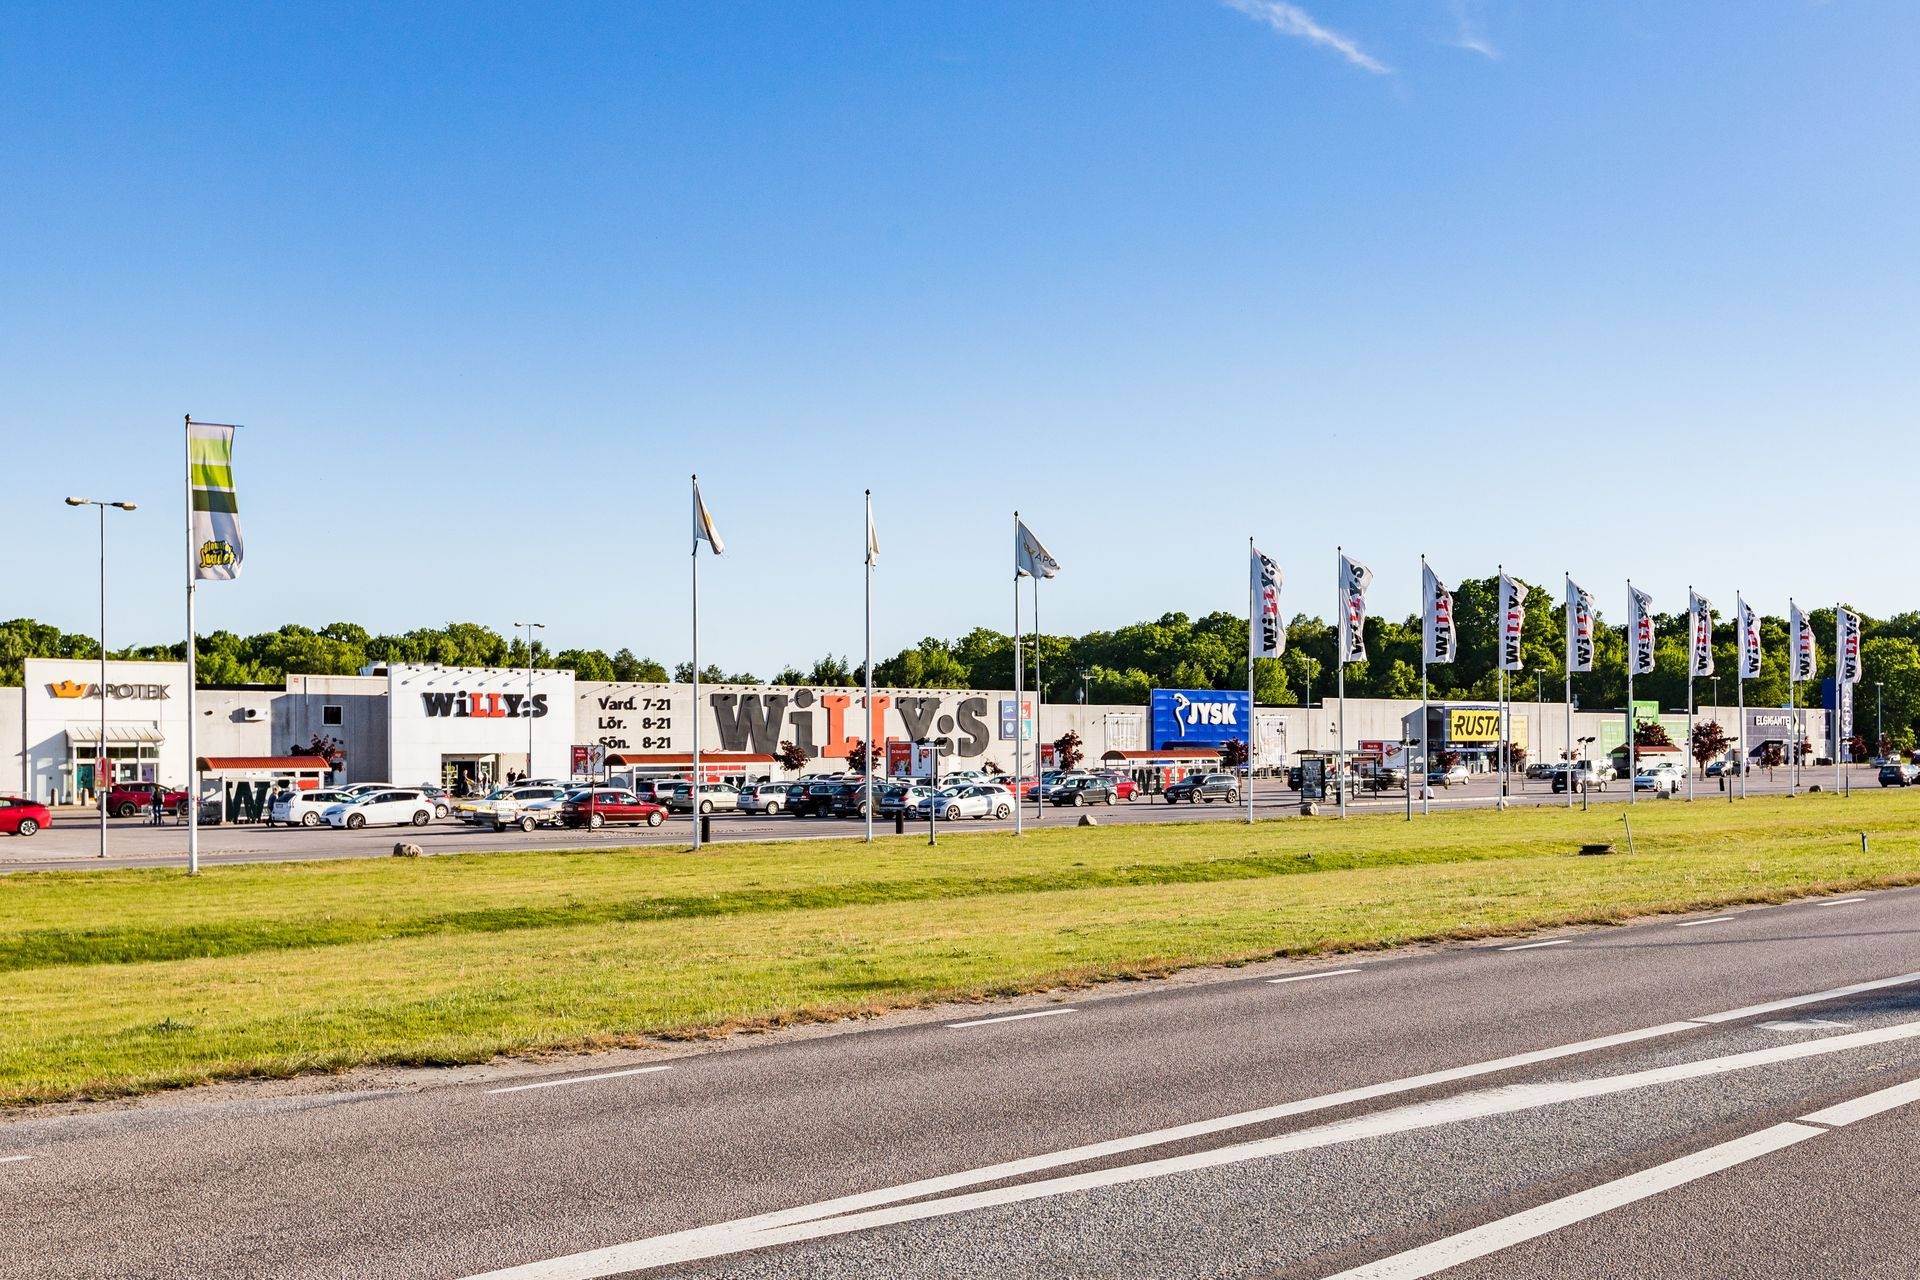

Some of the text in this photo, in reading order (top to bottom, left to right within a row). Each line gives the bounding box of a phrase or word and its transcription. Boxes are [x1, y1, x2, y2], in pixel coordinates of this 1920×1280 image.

[1034, 553, 1057, 567] APO
[91, 683, 171, 699] APOTEK
[597, 697, 672, 711] Vard. 7-21
[1187, 702, 1238, 725] JYSK
[598, 716, 672, 730] Lör. 8-21
[1453, 715, 1500, 736] RUSTA
[1755, 715, 1792, 727] ELGIGANTE
[598, 736, 672, 749] Sön. 8-21
